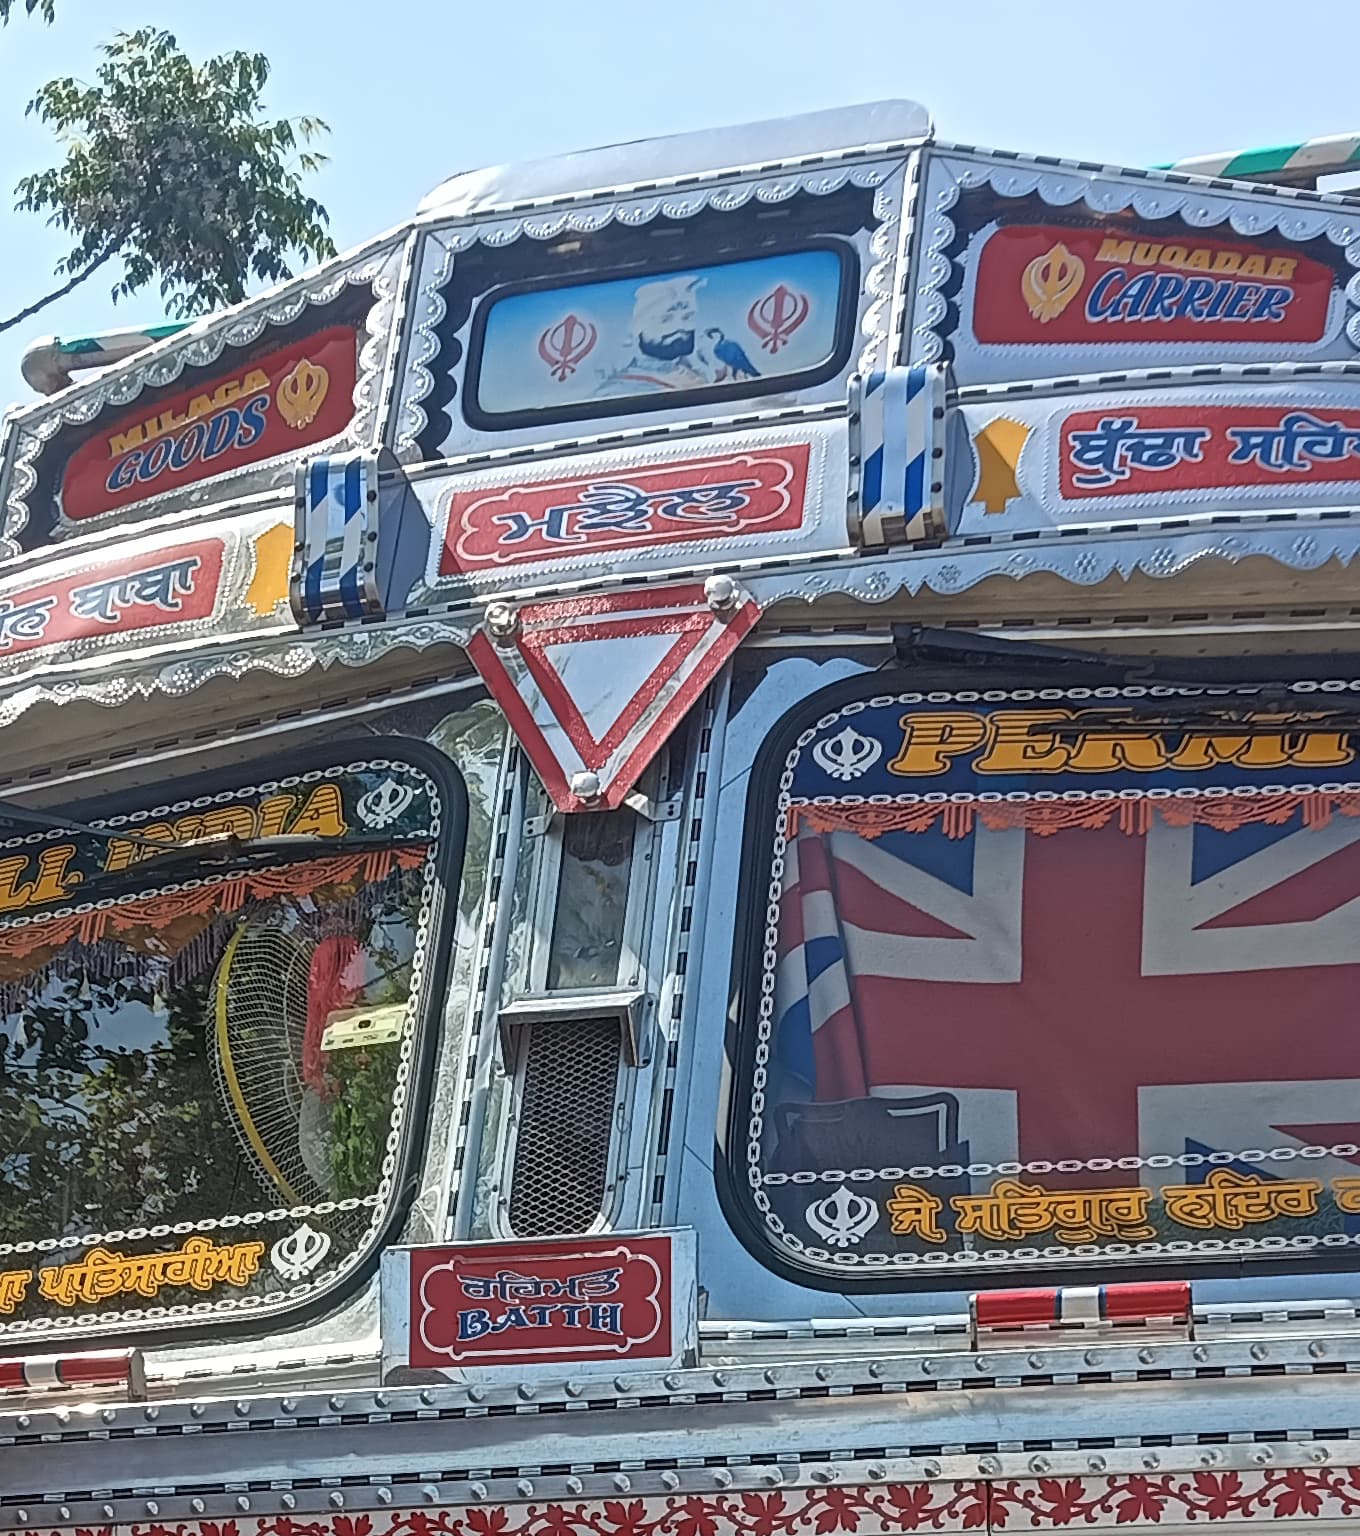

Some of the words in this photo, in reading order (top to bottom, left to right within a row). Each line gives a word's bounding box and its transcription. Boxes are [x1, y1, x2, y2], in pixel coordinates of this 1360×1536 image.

[1095, 239, 1297, 280] MUQADAR
[1085, 268, 1293, 323] CARRIER
[108, 369, 271, 457] MILAGA
[105, 394, 270, 493] GOODS
[69, 558, 200, 621] ਬਾਬਾ
[104, 783, 348, 873] INDIA
[886, 1184, 947, 1244] ਜੇ
[457, 1267, 623, 1304] ਰਹਿਮਤ
[456, 1303, 623, 1341] BATTH
